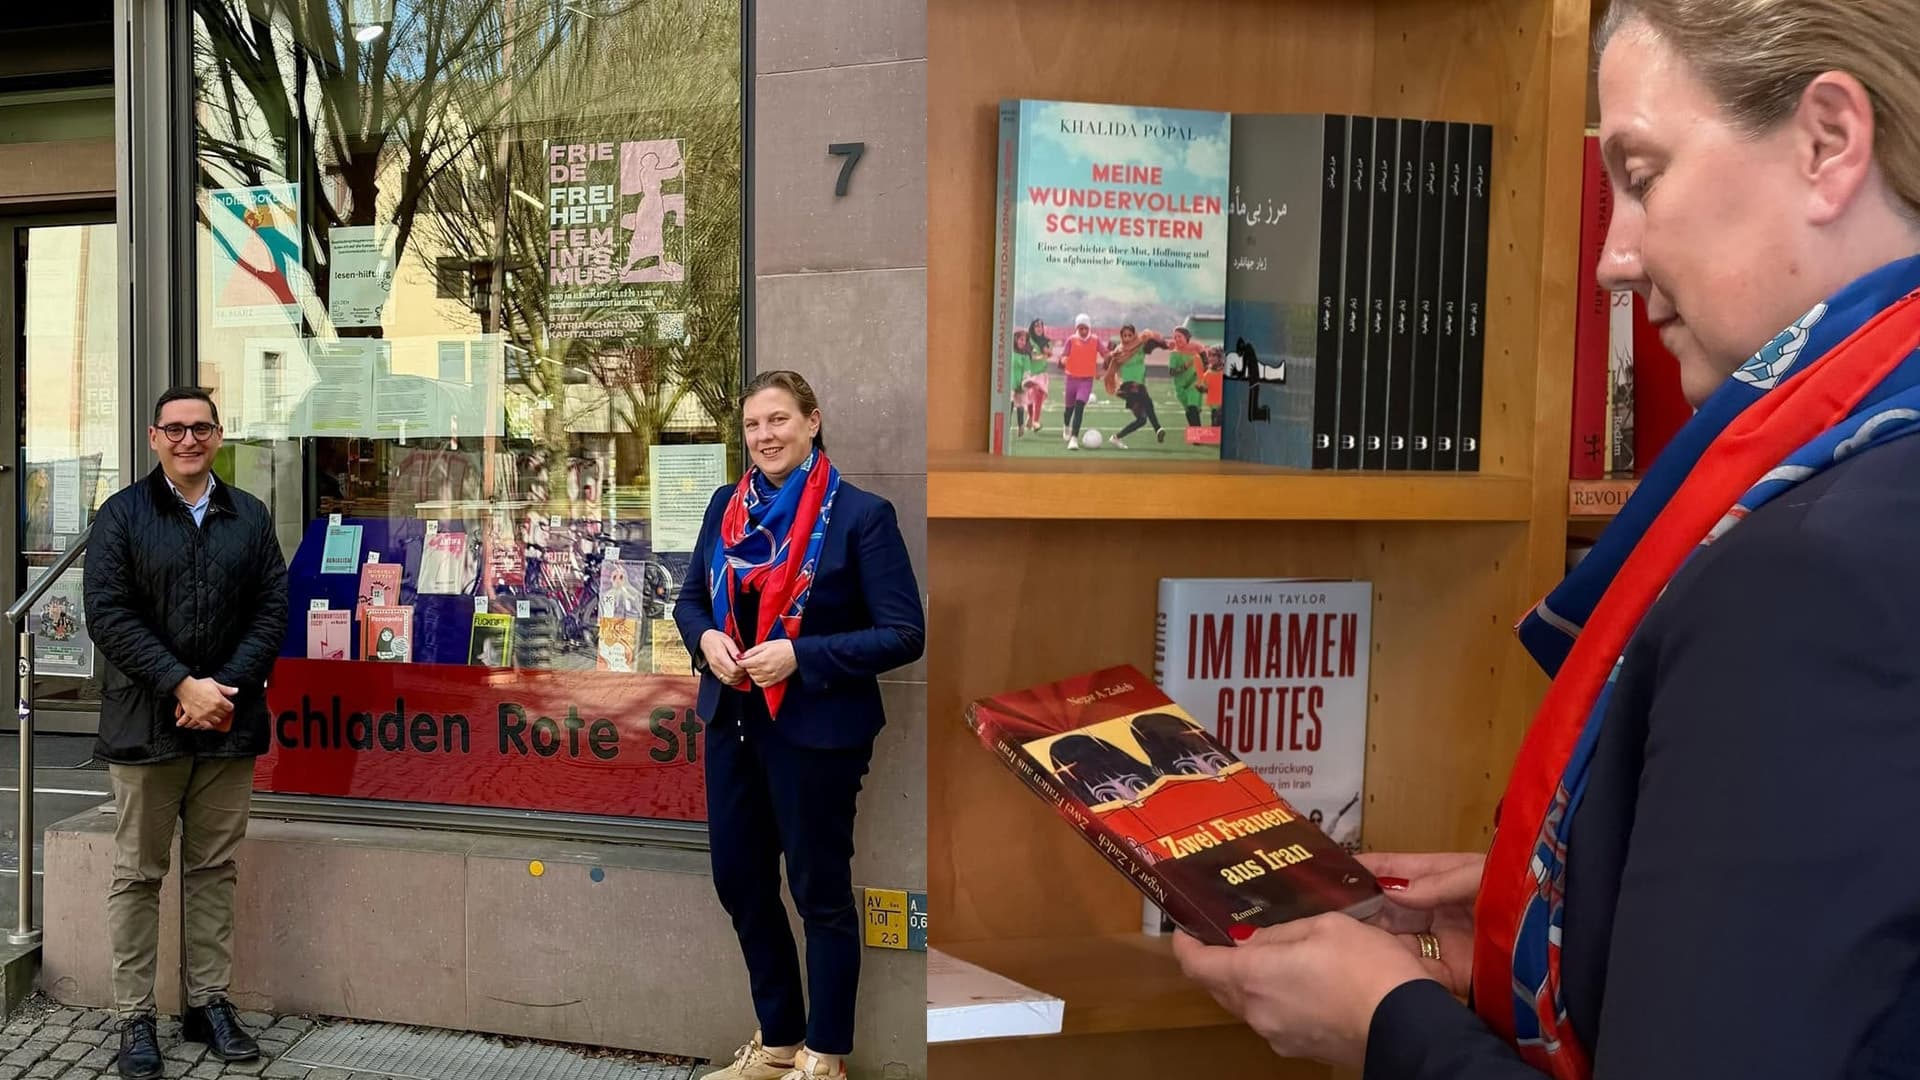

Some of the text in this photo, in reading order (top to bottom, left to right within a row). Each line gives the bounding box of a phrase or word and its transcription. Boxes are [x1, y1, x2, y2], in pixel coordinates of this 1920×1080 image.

[1060, 119, 1198, 140] KHALIDA POPAL
[550, 142, 614, 163] FRIE
[550, 163, 586, 183] DE
[829, 142, 864, 197] 7
[1092, 163, 1163, 185] MEINE
[550, 185, 614, 206] FREI
[1028, 186, 1221, 215] WUNDERVOLLEN
[550, 204, 613, 225] HEIT
[1046, 213, 1203, 240] SCHWESTERN
[550, 227, 613, 248] FEM
[1037, 242, 1209, 259] Eine Geschichte über Mut, Hoffnung und
[1046, 254, 1060, 263] das
[1063, 255, 1113, 266] afghanische
[550, 266, 611, 286] MUS
[549, 313, 581, 322] STATT
[549, 320, 644, 330] PATRIARCHAT UND
[549, 329, 624, 338] KAPITALISMUS
[1614, 416, 1623, 456] Reclam
[1225, 594, 1326, 605] JASMIN TAYLOR
[1187, 612, 1357, 680] IM NAMEN
[1066, 694, 1096, 706] Negar
[1104, 682, 1135, 696] Zadeh
[276, 695, 703, 763] chladen Rote St
[1216, 685, 1324, 754] GOTTES
[1253, 763, 1313, 776] terdrückung
[998, 740, 1090, 830] Zwei Frauen aus Iran
[1278, 780, 1290, 789] im
[1293, 780, 1311, 789] Iran
[1157, 807, 1295, 859] Zwei Frauen
[1098, 833, 1128, 866] Zadeh
[1220, 843, 1313, 885] aus Iran
[1139, 872, 1168, 903] Negar
[868, 896, 881, 907] AV
[911, 899, 917, 911] A
[910, 916, 927, 929] 0,6
[1231, 905, 1263, 922] Roman
[882, 932, 899, 945] 2,3
